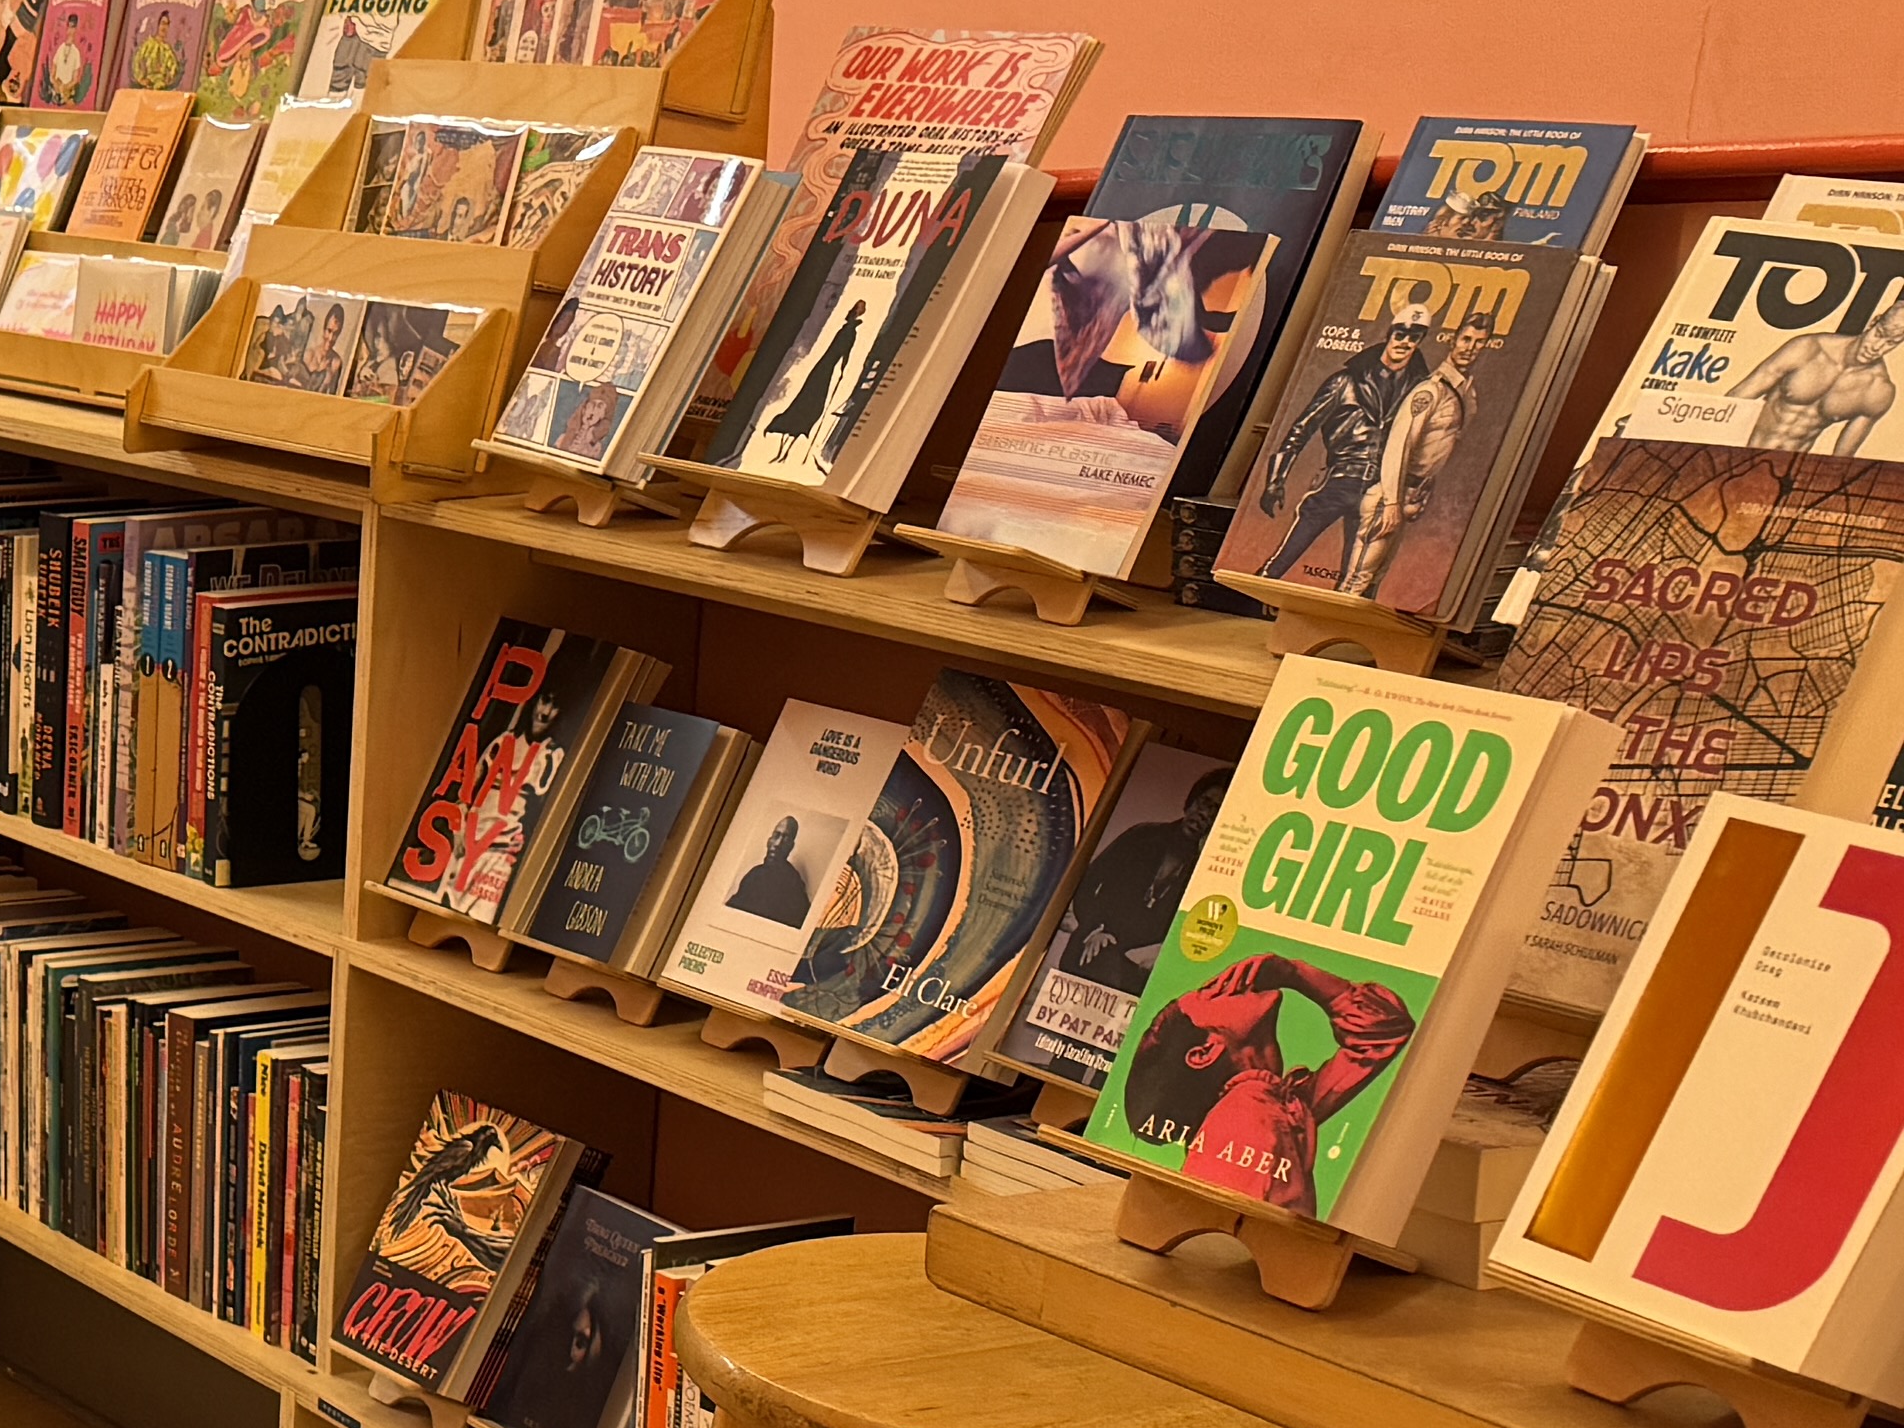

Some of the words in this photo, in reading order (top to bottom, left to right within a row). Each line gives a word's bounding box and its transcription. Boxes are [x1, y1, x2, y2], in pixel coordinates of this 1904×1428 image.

[842, 45, 904, 81] OUR
[896, 47, 985, 87] WORK
[984, 52, 1032, 89] IS
[848, 83, 1042, 129] EVERYWHERE
[1425, 139, 1589, 208] TOM
[823, 187, 972, 248] DJUNA
[606, 224, 687, 264] TRANS
[590, 258, 674, 297] HISTORY
[1358, 256, 1531, 337] TOM
[95, 300, 147, 329] HAPPY
[1651, 339, 1731, 384] kake
[1656, 394, 1738, 423] Signed!
[1583, 558, 1818, 628] SACRED
[238, 615, 274, 636] The
[1603, 635, 1730, 696] LIPS
[618, 720, 644, 752] TAKE
[647, 727, 672, 758] ME
[922, 713, 1066, 797] Unfurl
[1623, 715, 1737, 775] THE
[648, 768, 675, 798] YOU
[1261, 697, 1513, 833] GOOD
[564, 860, 605, 893] ANDREA
[1241, 811, 1428, 946] GIRL
[565, 900, 608, 936] GIBSON
[880, 962, 917, 997] Eli
[917, 976, 978, 1019] Clare
[1138, 1114, 1205, 1154] ARIA
[1216, 1141, 1292, 1183] ABER
[388, 1346, 438, 1381] DESERT
